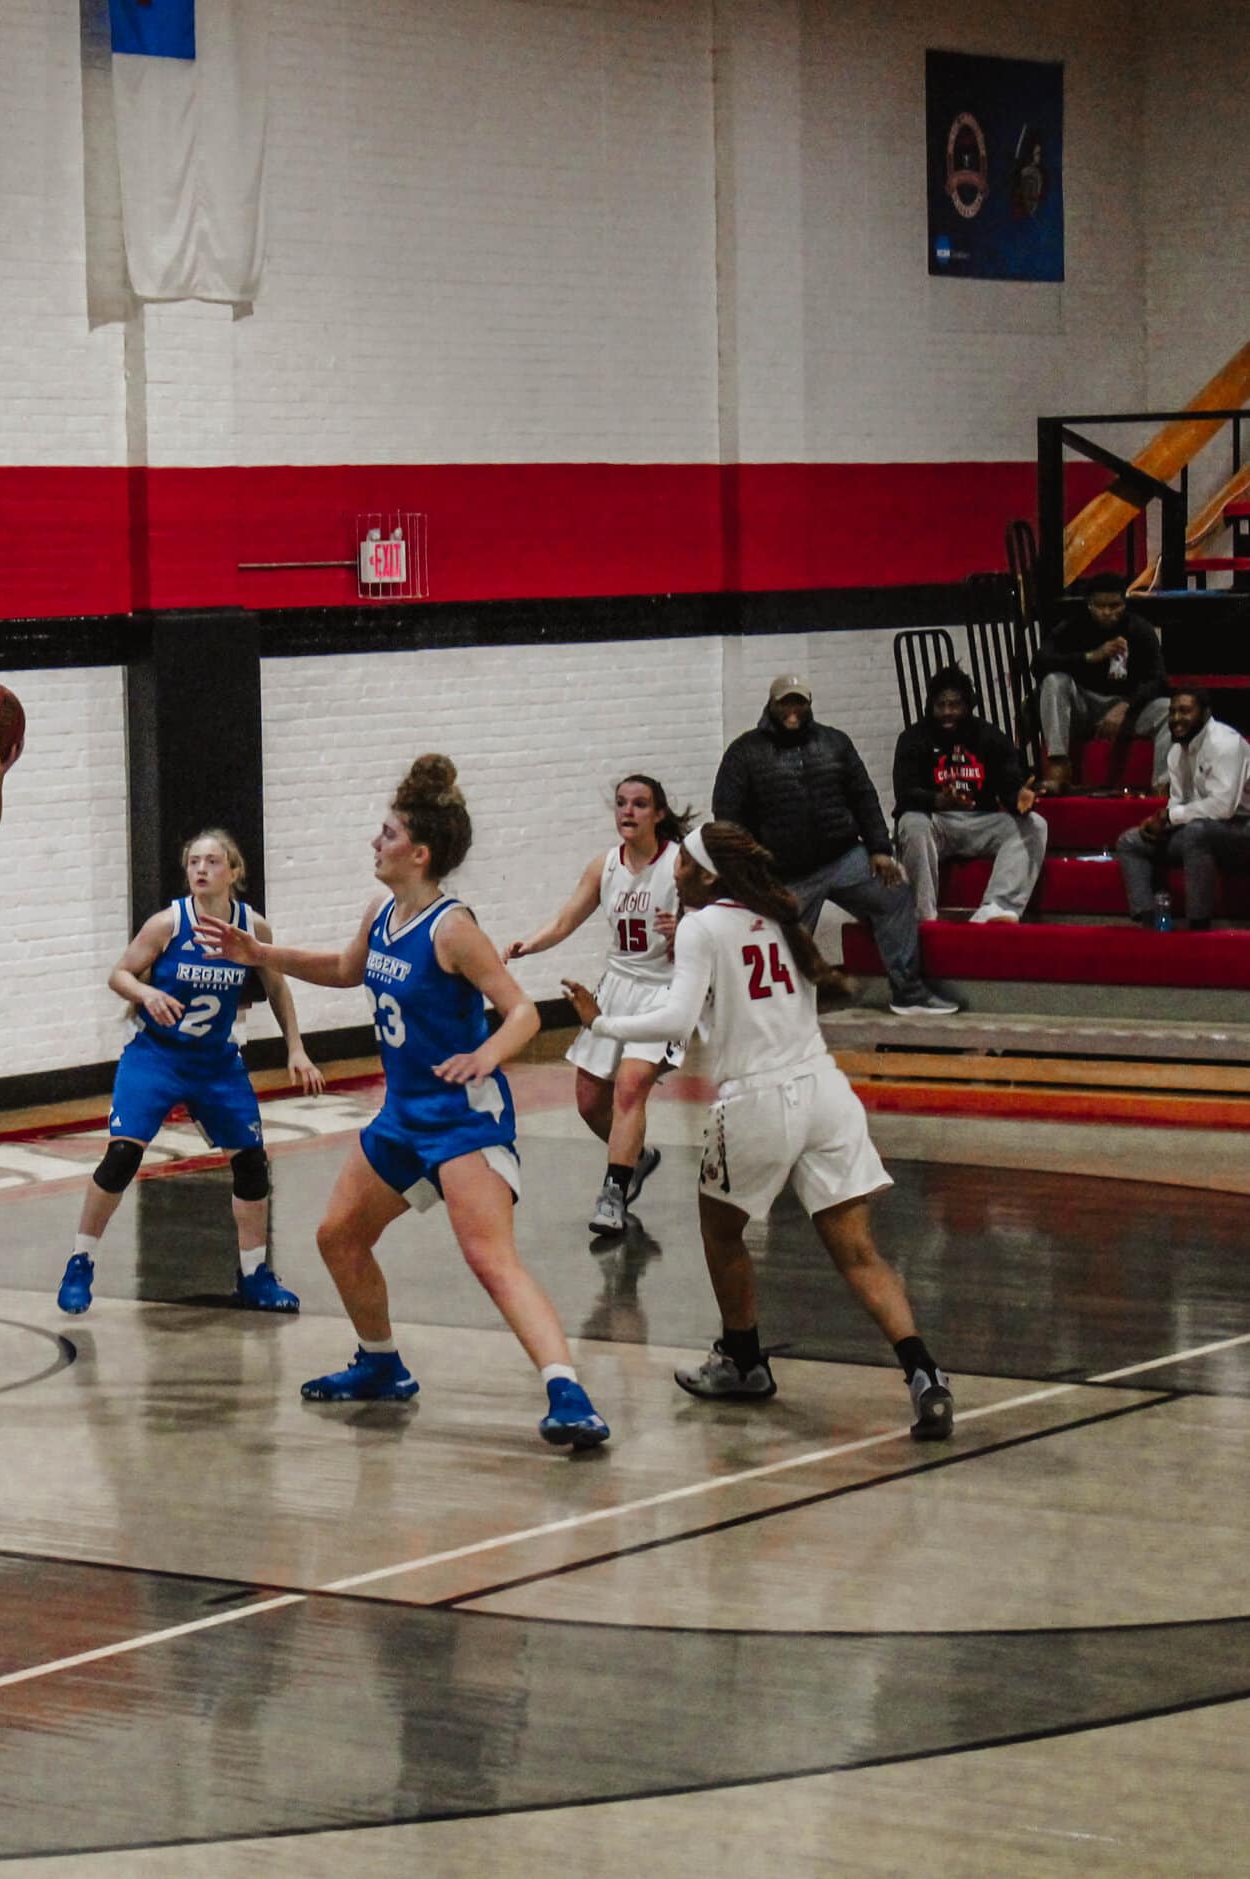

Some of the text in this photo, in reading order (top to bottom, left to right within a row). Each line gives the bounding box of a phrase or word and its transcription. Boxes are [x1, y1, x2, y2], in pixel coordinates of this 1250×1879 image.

[375, 543, 401, 578] EXIT
[617, 918, 648, 952] 15
[176, 962, 246, 985] REGENT
[742, 943, 796, 1000] 24
[178, 994, 221, 1038] 2
